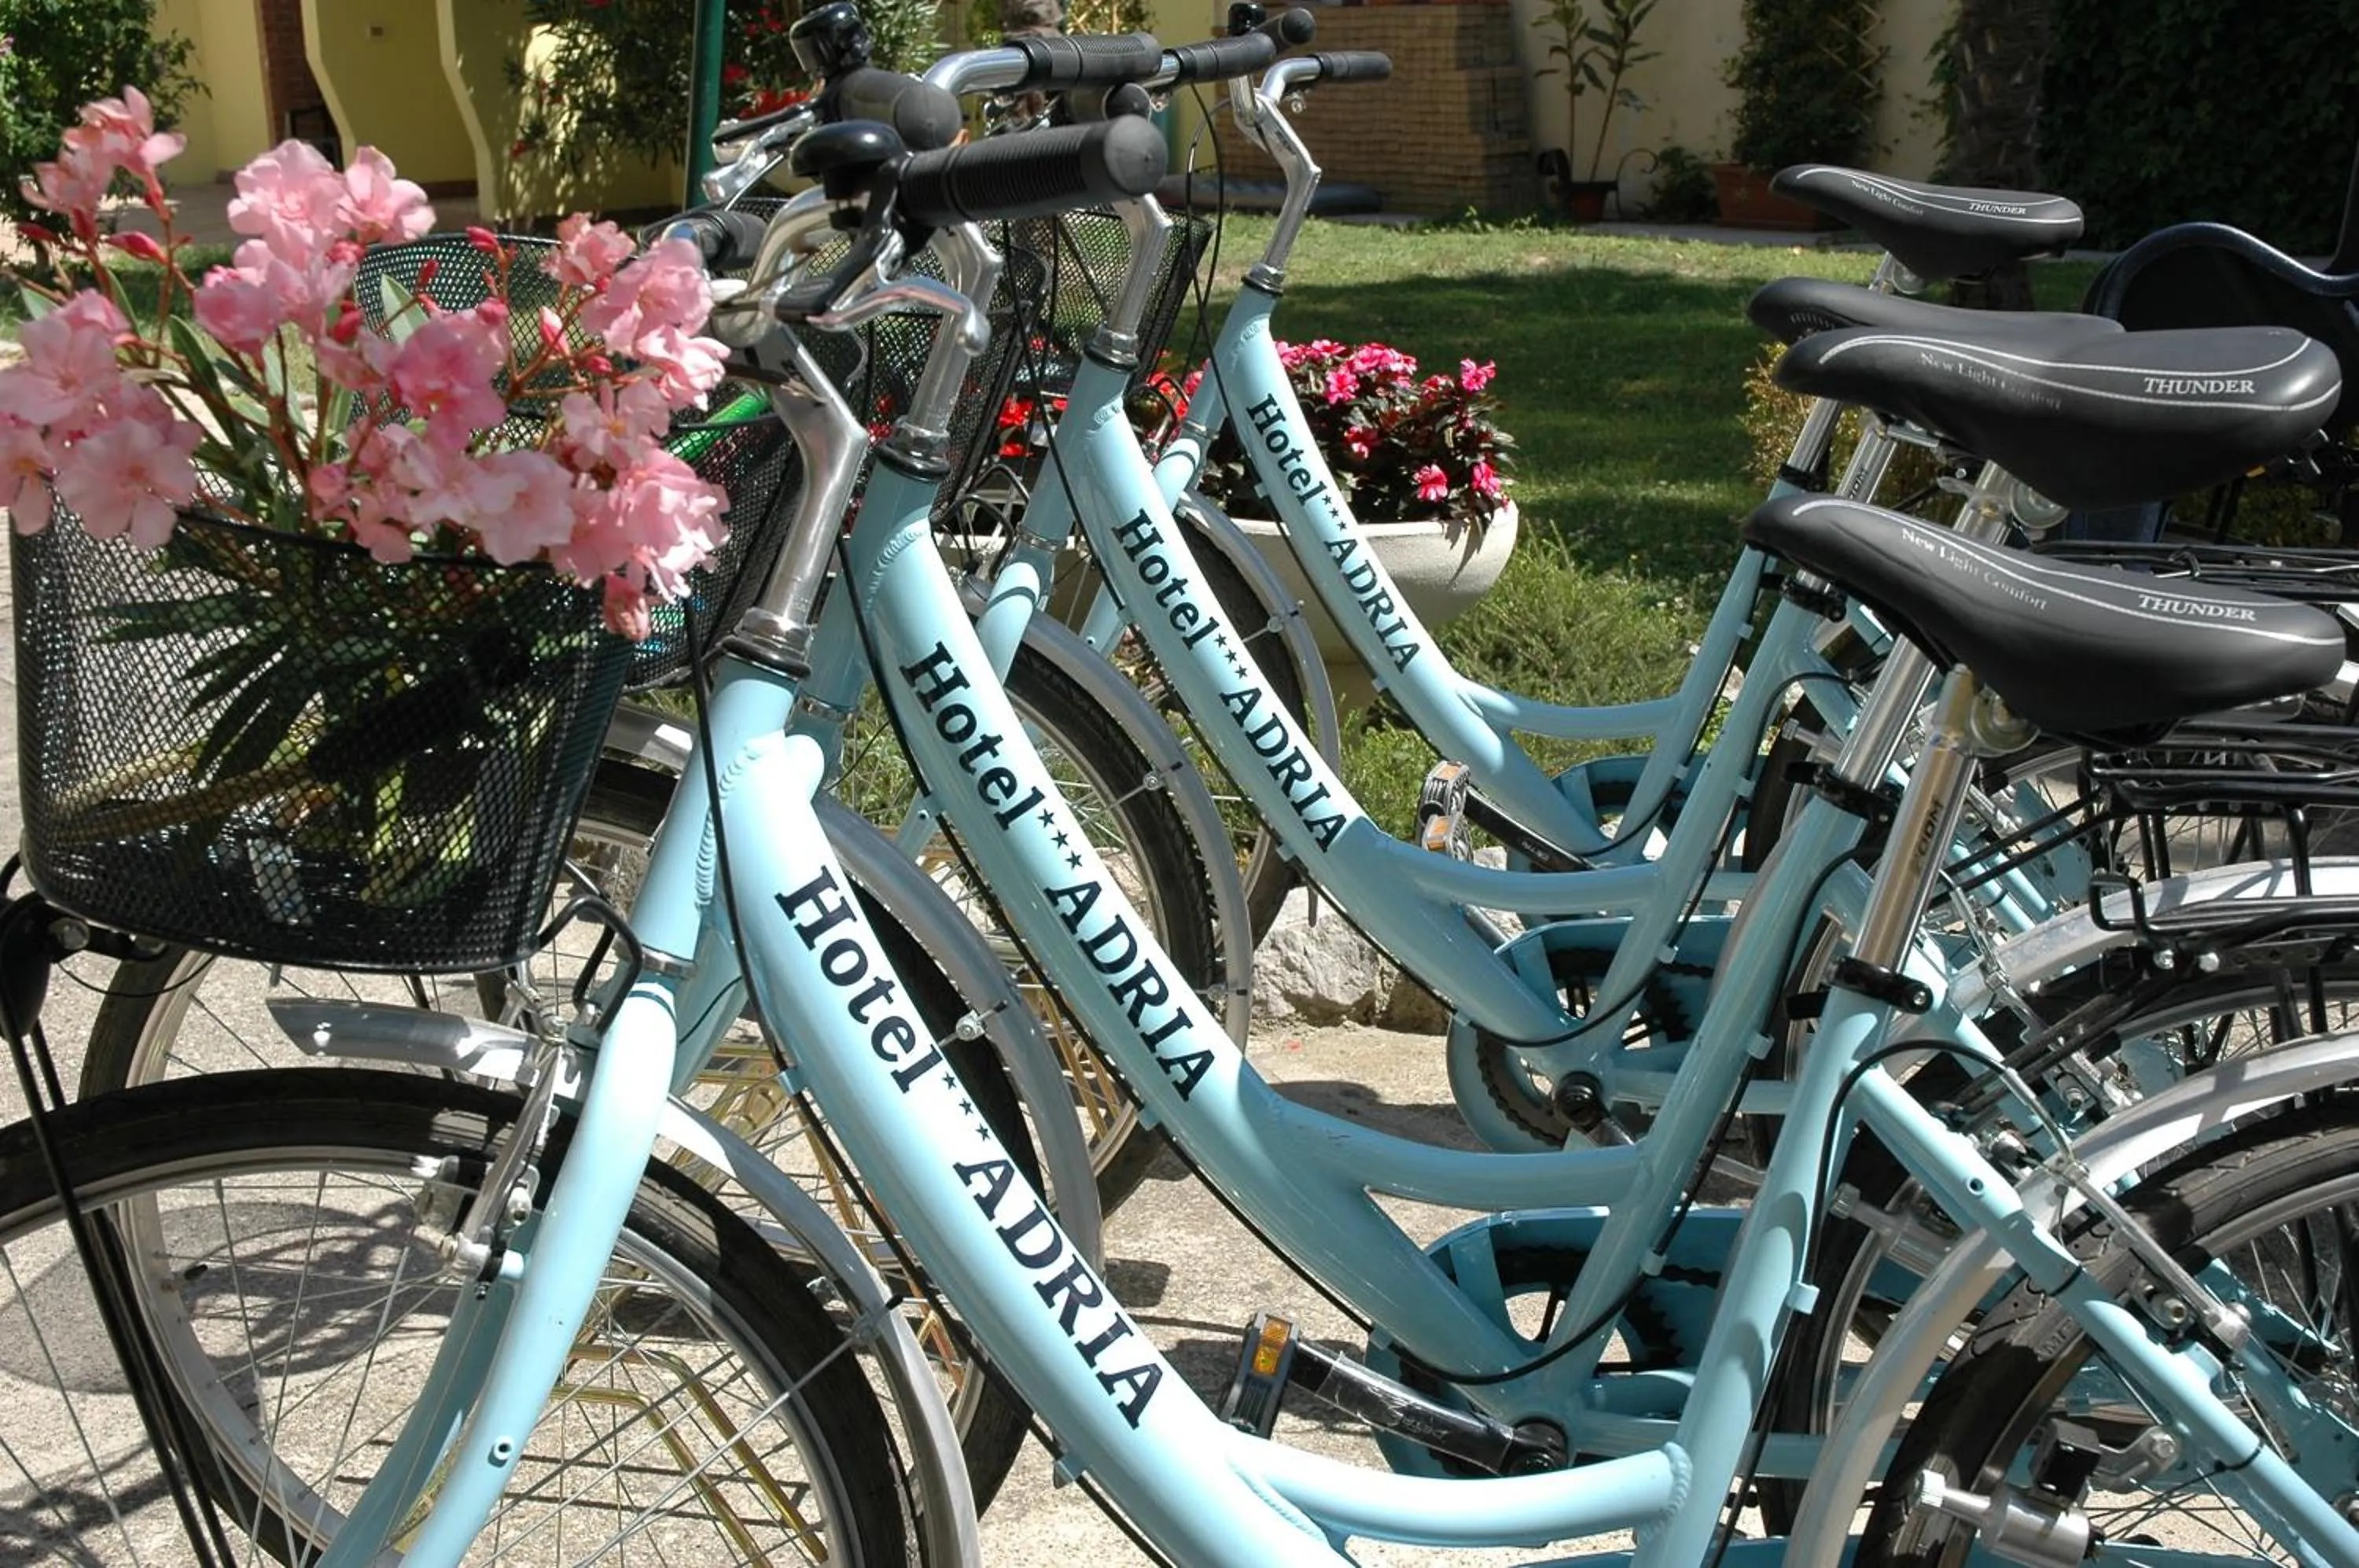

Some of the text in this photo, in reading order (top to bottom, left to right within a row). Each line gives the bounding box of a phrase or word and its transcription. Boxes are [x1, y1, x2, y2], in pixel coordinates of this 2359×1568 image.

[1968, 202, 2027, 215] THUNDER
[1919, 352, 1954, 372] New
[2144, 376, 2256, 394] THUNDER
[1246, 393, 1421, 675] Hotel ADRIA
[1901, 528, 1936, 552] New
[1938, 545, 1979, 576] Light
[2138, 594, 2257, 621] THUNDER
[1110, 509, 1348, 853] Hotel ADRIA
[900, 641, 1215, 1102] Hotel ADRIA
[774, 865, 1164, 1430] Hotel ADRIA
